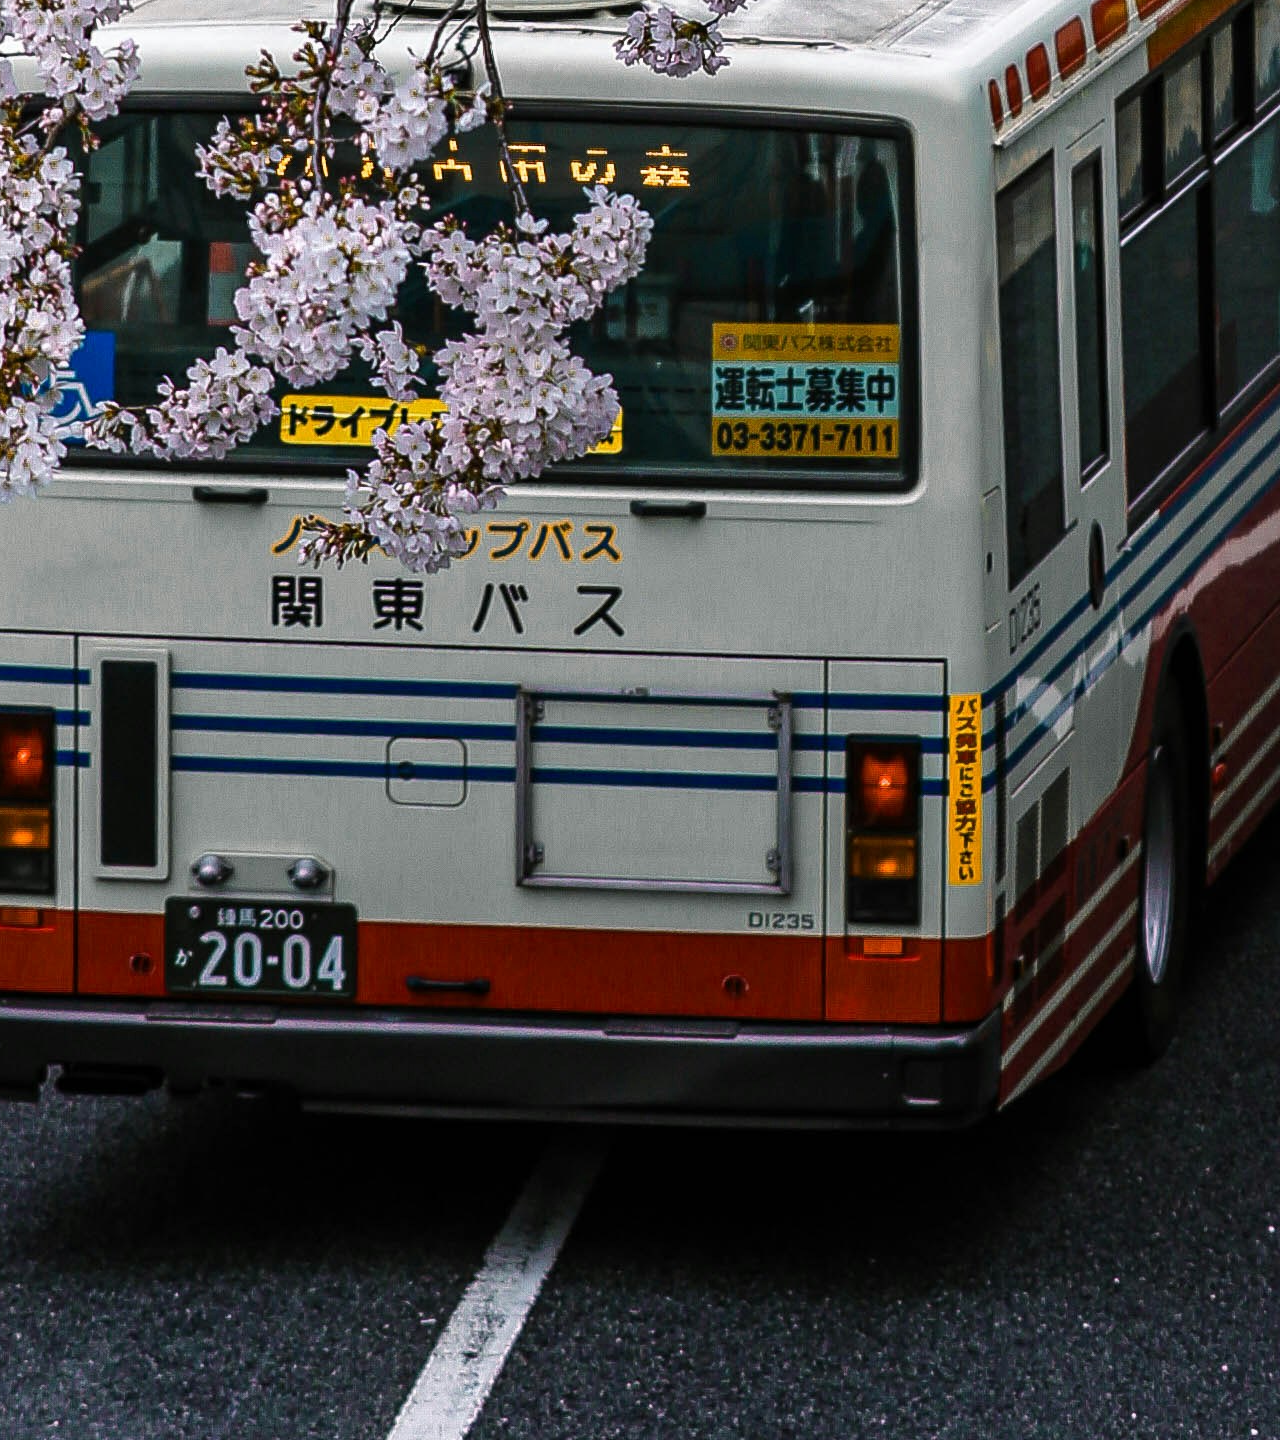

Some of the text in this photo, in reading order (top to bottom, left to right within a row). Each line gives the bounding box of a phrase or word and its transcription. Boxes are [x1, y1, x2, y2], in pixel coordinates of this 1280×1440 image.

[742, 333, 893, 353] 関東バス株式会社
[715, 366, 896, 413] 運転士募集中
[717, 421, 894, 451] 03-3371-7111
[271, 574, 625, 637] 関東バス
[955, 698, 979, 881] バス発車にご協力下さい
[748, 911, 814, 930] D1235
[199, 930, 346, 991] 20-04
